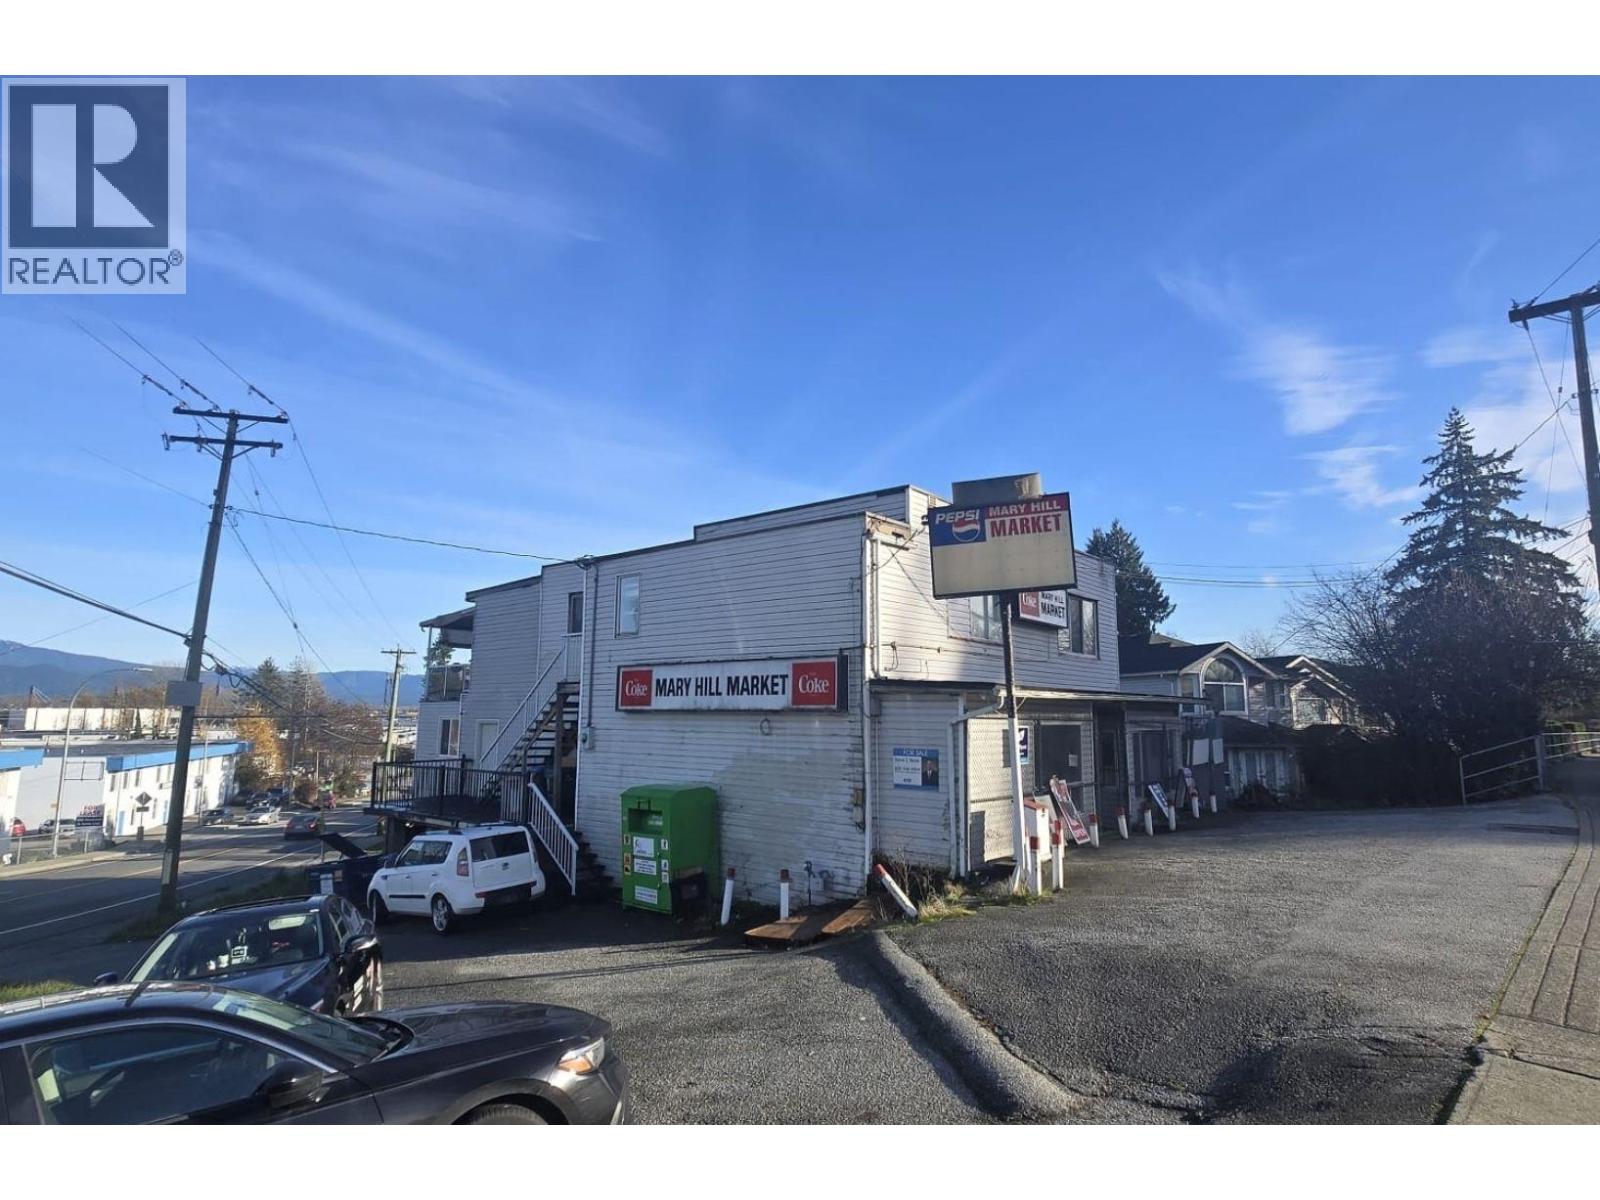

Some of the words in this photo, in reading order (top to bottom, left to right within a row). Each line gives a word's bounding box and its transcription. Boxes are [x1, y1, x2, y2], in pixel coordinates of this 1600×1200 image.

[935, 509, 980, 525] PEPSI
[989, 504, 1027, 518] MARY
[1031, 499, 1061, 512] HILL
[990, 514, 1062, 538] MARKET
[1041, 602, 1065, 618] MARKET
[625, 679, 648, 697] Coke
[655, 677, 692, 697] MARY
[695, 676, 722, 697] HILL
[726, 674, 789, 696] MARKET
[798, 674, 830, 694] Coke
